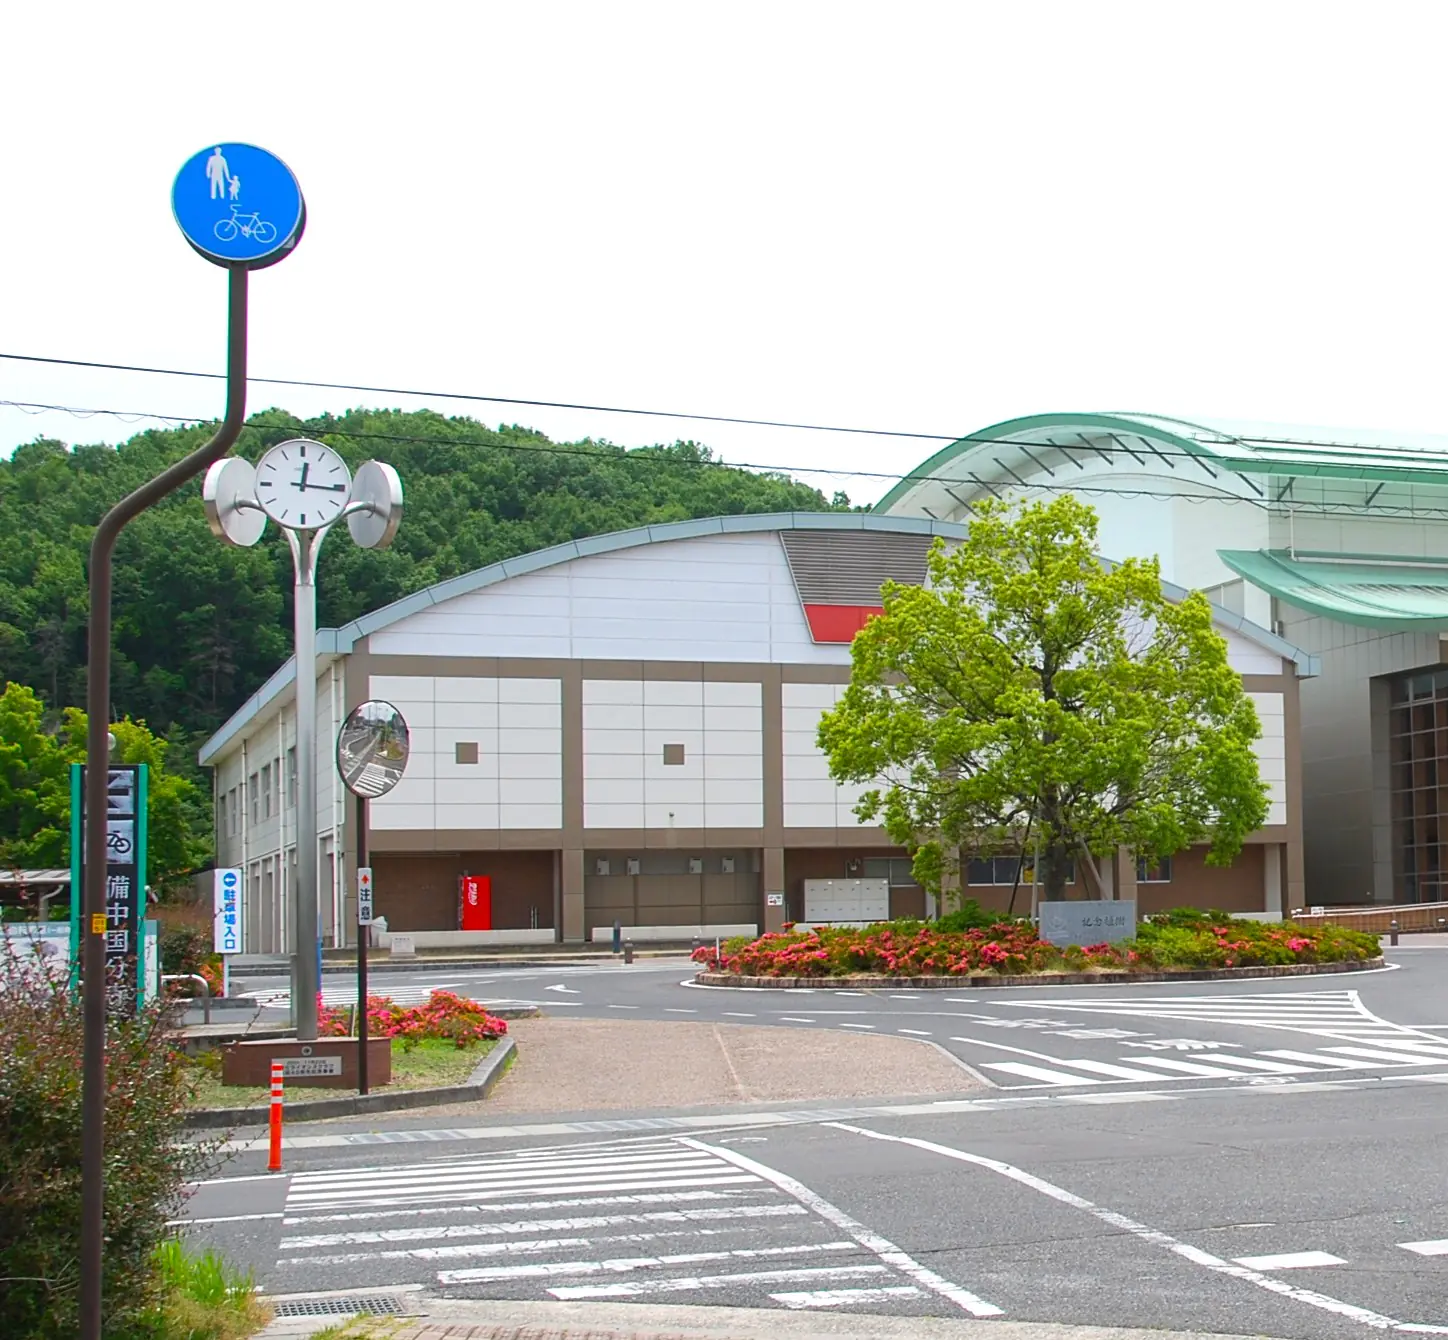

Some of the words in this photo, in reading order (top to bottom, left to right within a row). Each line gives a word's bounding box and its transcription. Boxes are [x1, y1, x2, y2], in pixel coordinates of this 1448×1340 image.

[223, 889, 236, 949] 駐車場入口
[360, 888, 370, 920] 注意
